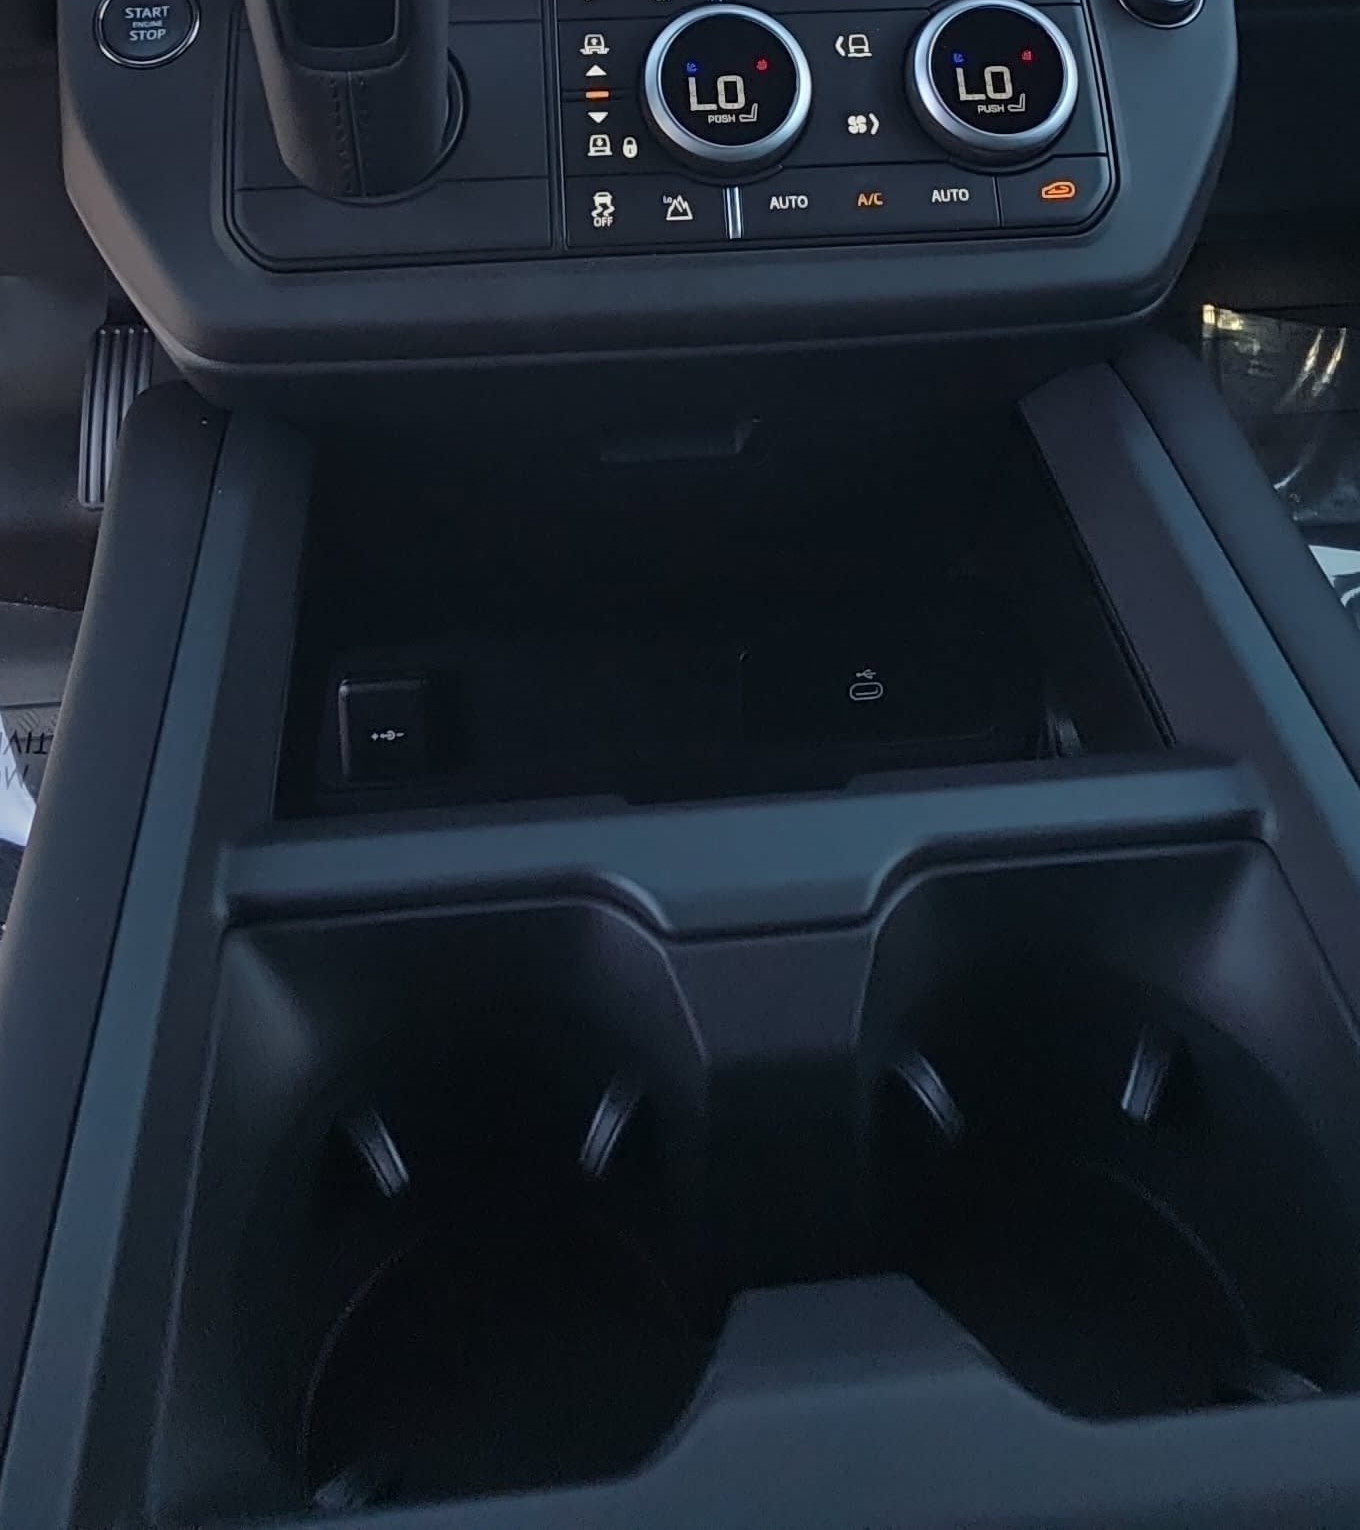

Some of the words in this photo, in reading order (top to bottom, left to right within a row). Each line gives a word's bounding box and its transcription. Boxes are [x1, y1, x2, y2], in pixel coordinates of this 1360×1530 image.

[124, 6, 171, 19] START
[131, 20, 163, 29] ENGINE
[129, 29, 167, 42] STOP
[955, 65, 1013, 102] LO
[687, 74, 746, 112] LO
[977, 104, 1005, 113] PUSH
[707, 114, 736, 123] PUSH
[769, 194, 809, 210] AUTO
[857, 192, 884, 207] A/C
[931, 188, 970, 203] AUTO
[593, 216, 614, 227] OFF
